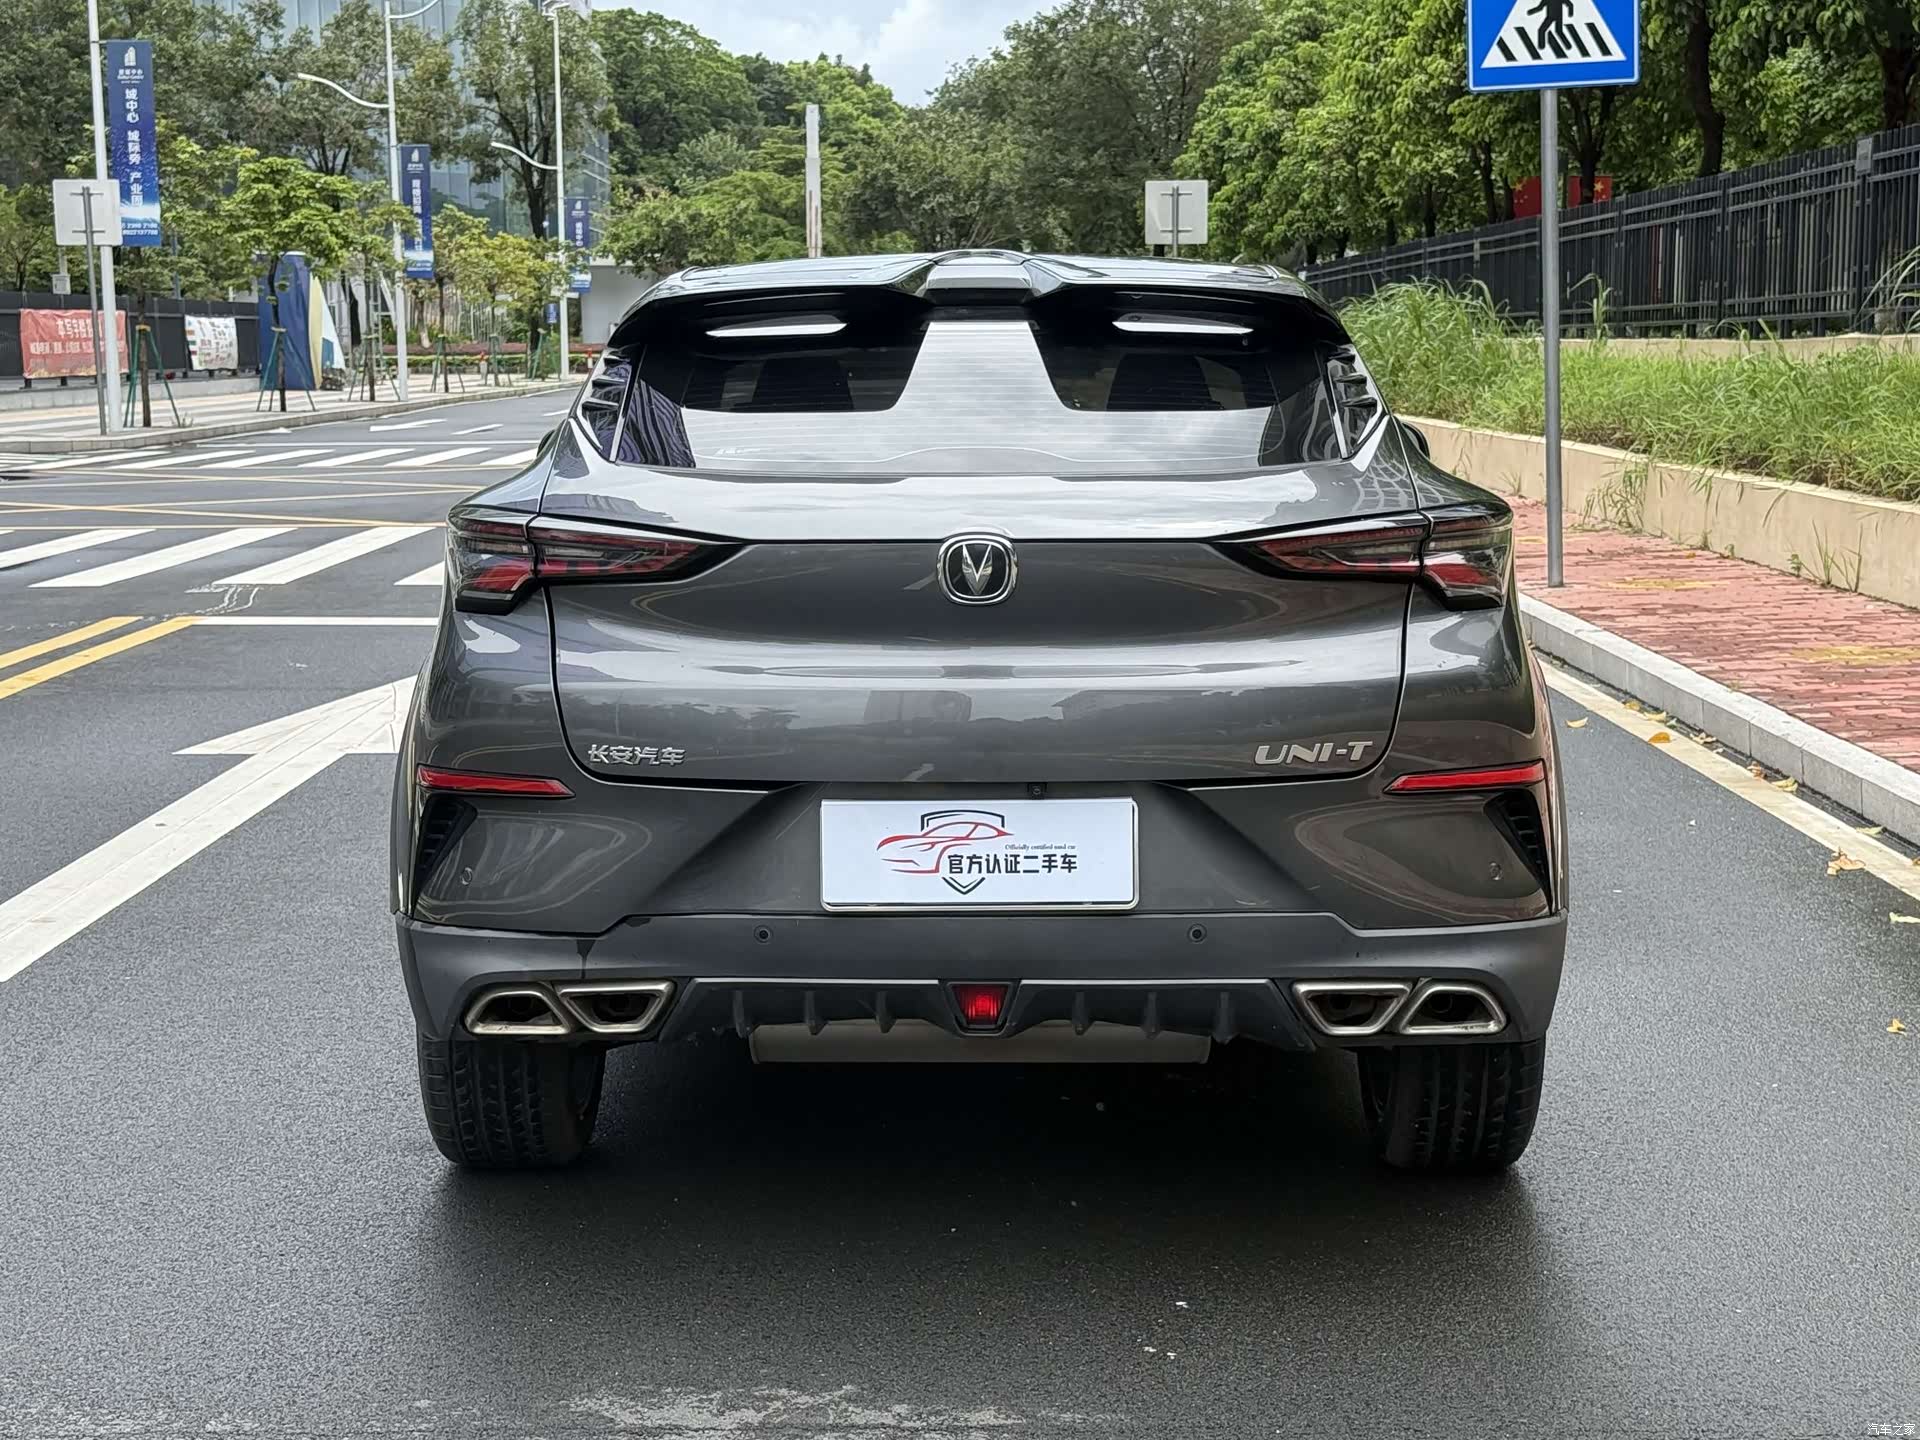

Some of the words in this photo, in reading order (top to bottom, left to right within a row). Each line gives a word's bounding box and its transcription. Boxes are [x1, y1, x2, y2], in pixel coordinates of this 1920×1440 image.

[588, 744, 686, 766] 长安汽车
[1254, 740, 1373, 765] UNI-T
[1005, 843, 1030, 851] Officially
[948, 853, 1078, 874] 官方认证二手车
